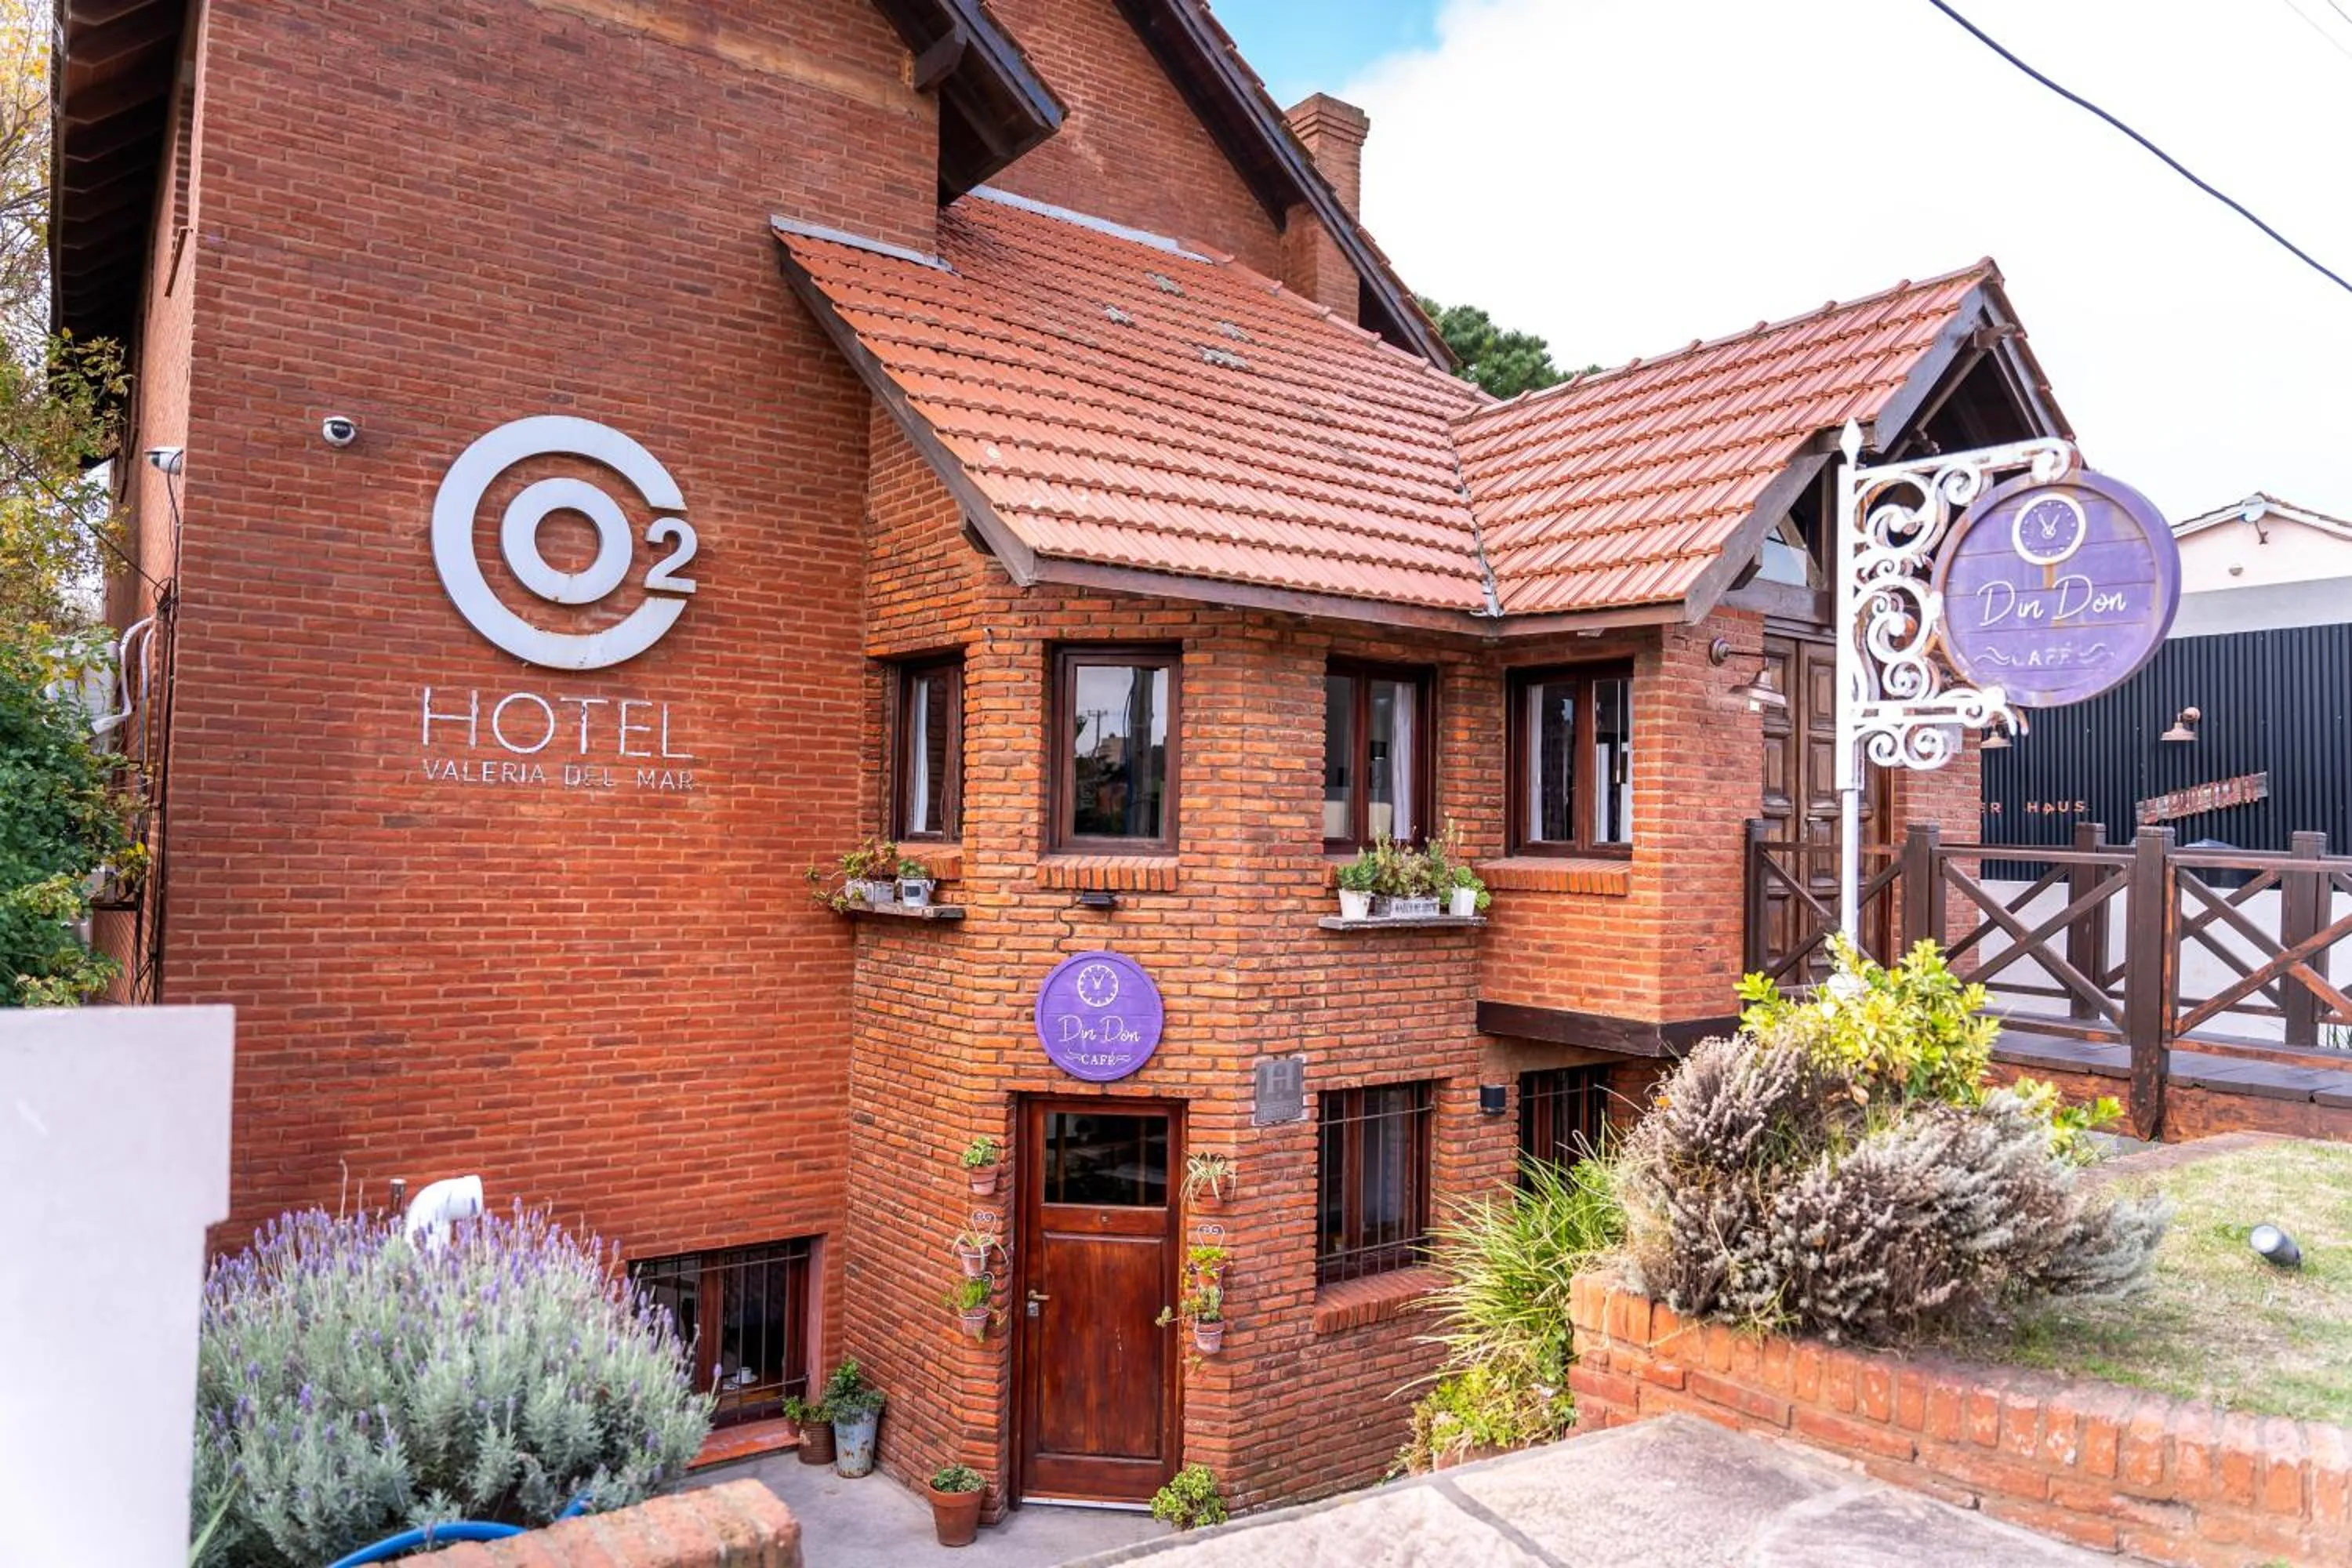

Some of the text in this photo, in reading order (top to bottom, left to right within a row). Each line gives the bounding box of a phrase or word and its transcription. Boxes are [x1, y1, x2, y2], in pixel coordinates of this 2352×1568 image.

[1976, 575, 2126, 626] Din Don
[423, 687, 695, 759] HOTEL
[423, 758, 694, 790] VALERIA DEL MAR
[2026, 800, 2085, 815] HAUS
[1059, 1014, 1141, 1044] Din Don
[1080, 1052, 1116, 1065] CAFÉ
